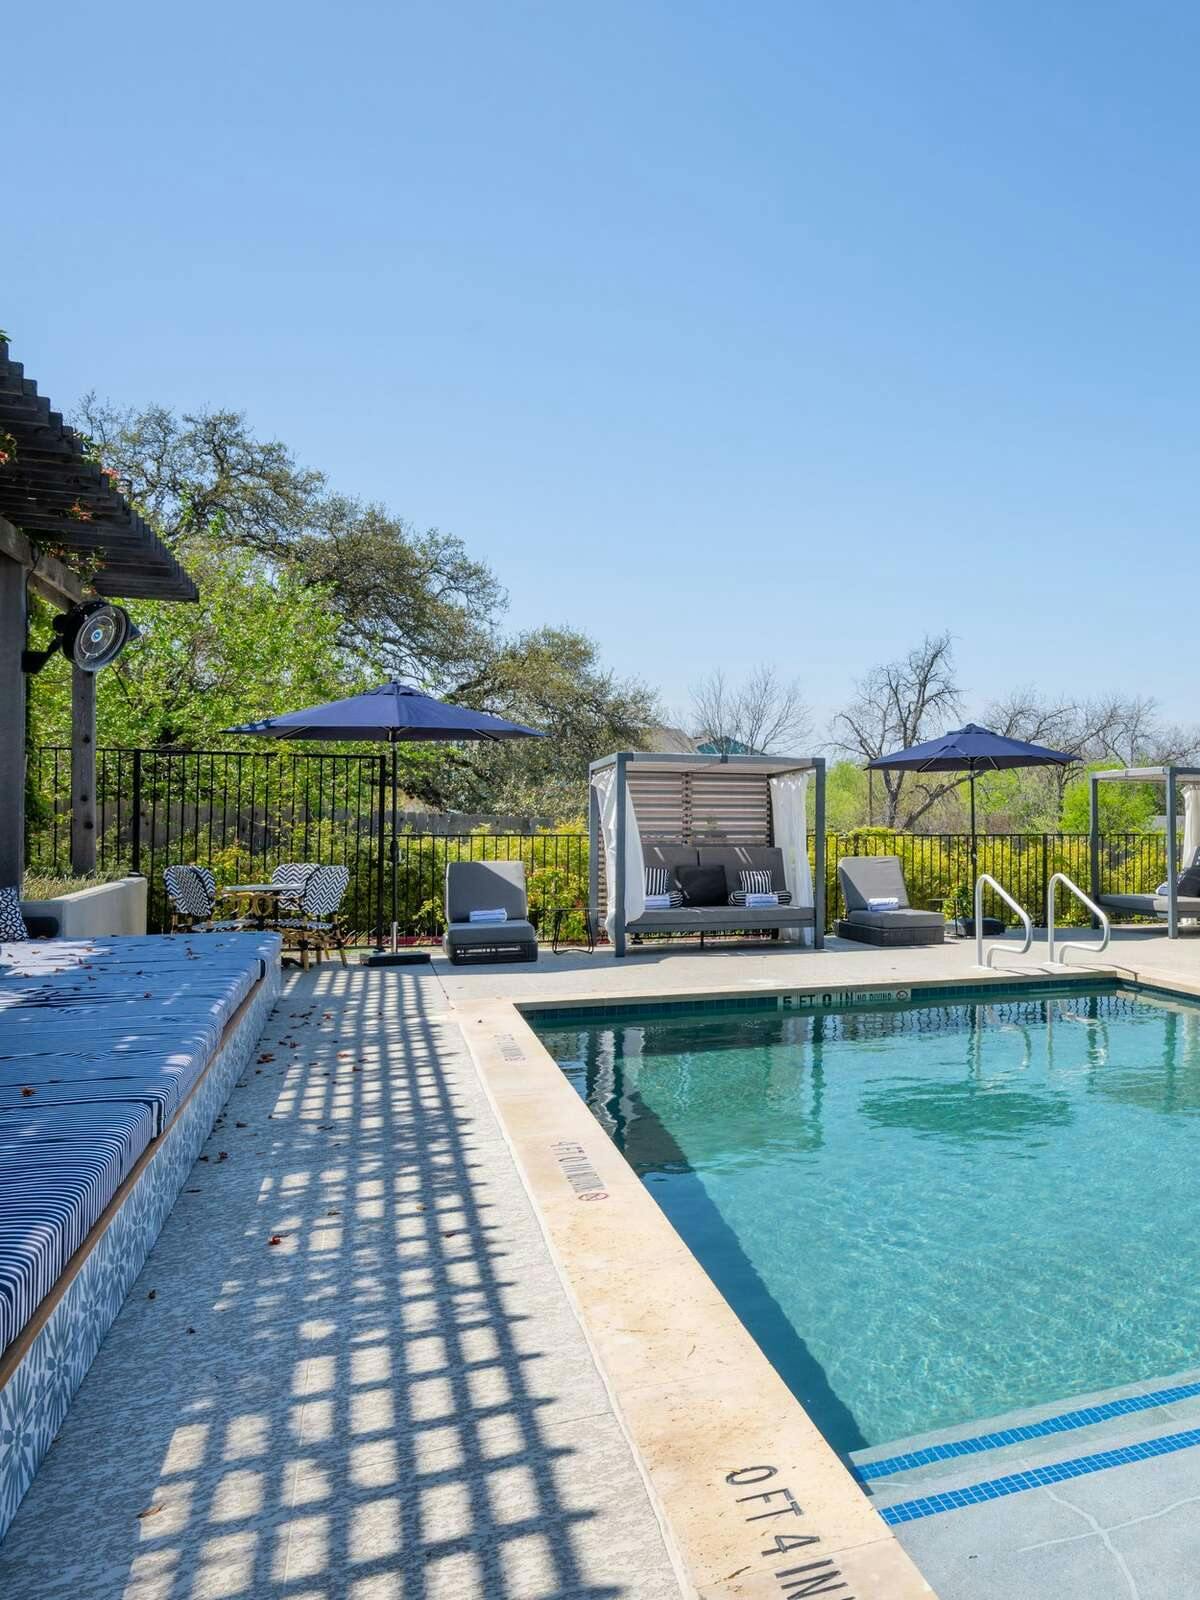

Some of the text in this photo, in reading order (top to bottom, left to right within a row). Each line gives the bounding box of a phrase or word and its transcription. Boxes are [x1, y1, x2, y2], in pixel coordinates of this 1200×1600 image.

[736, 1488, 803, 1522] FT
[761, 1536, 820, 1557] 4
[775, 1559, 848, 1600] IN
